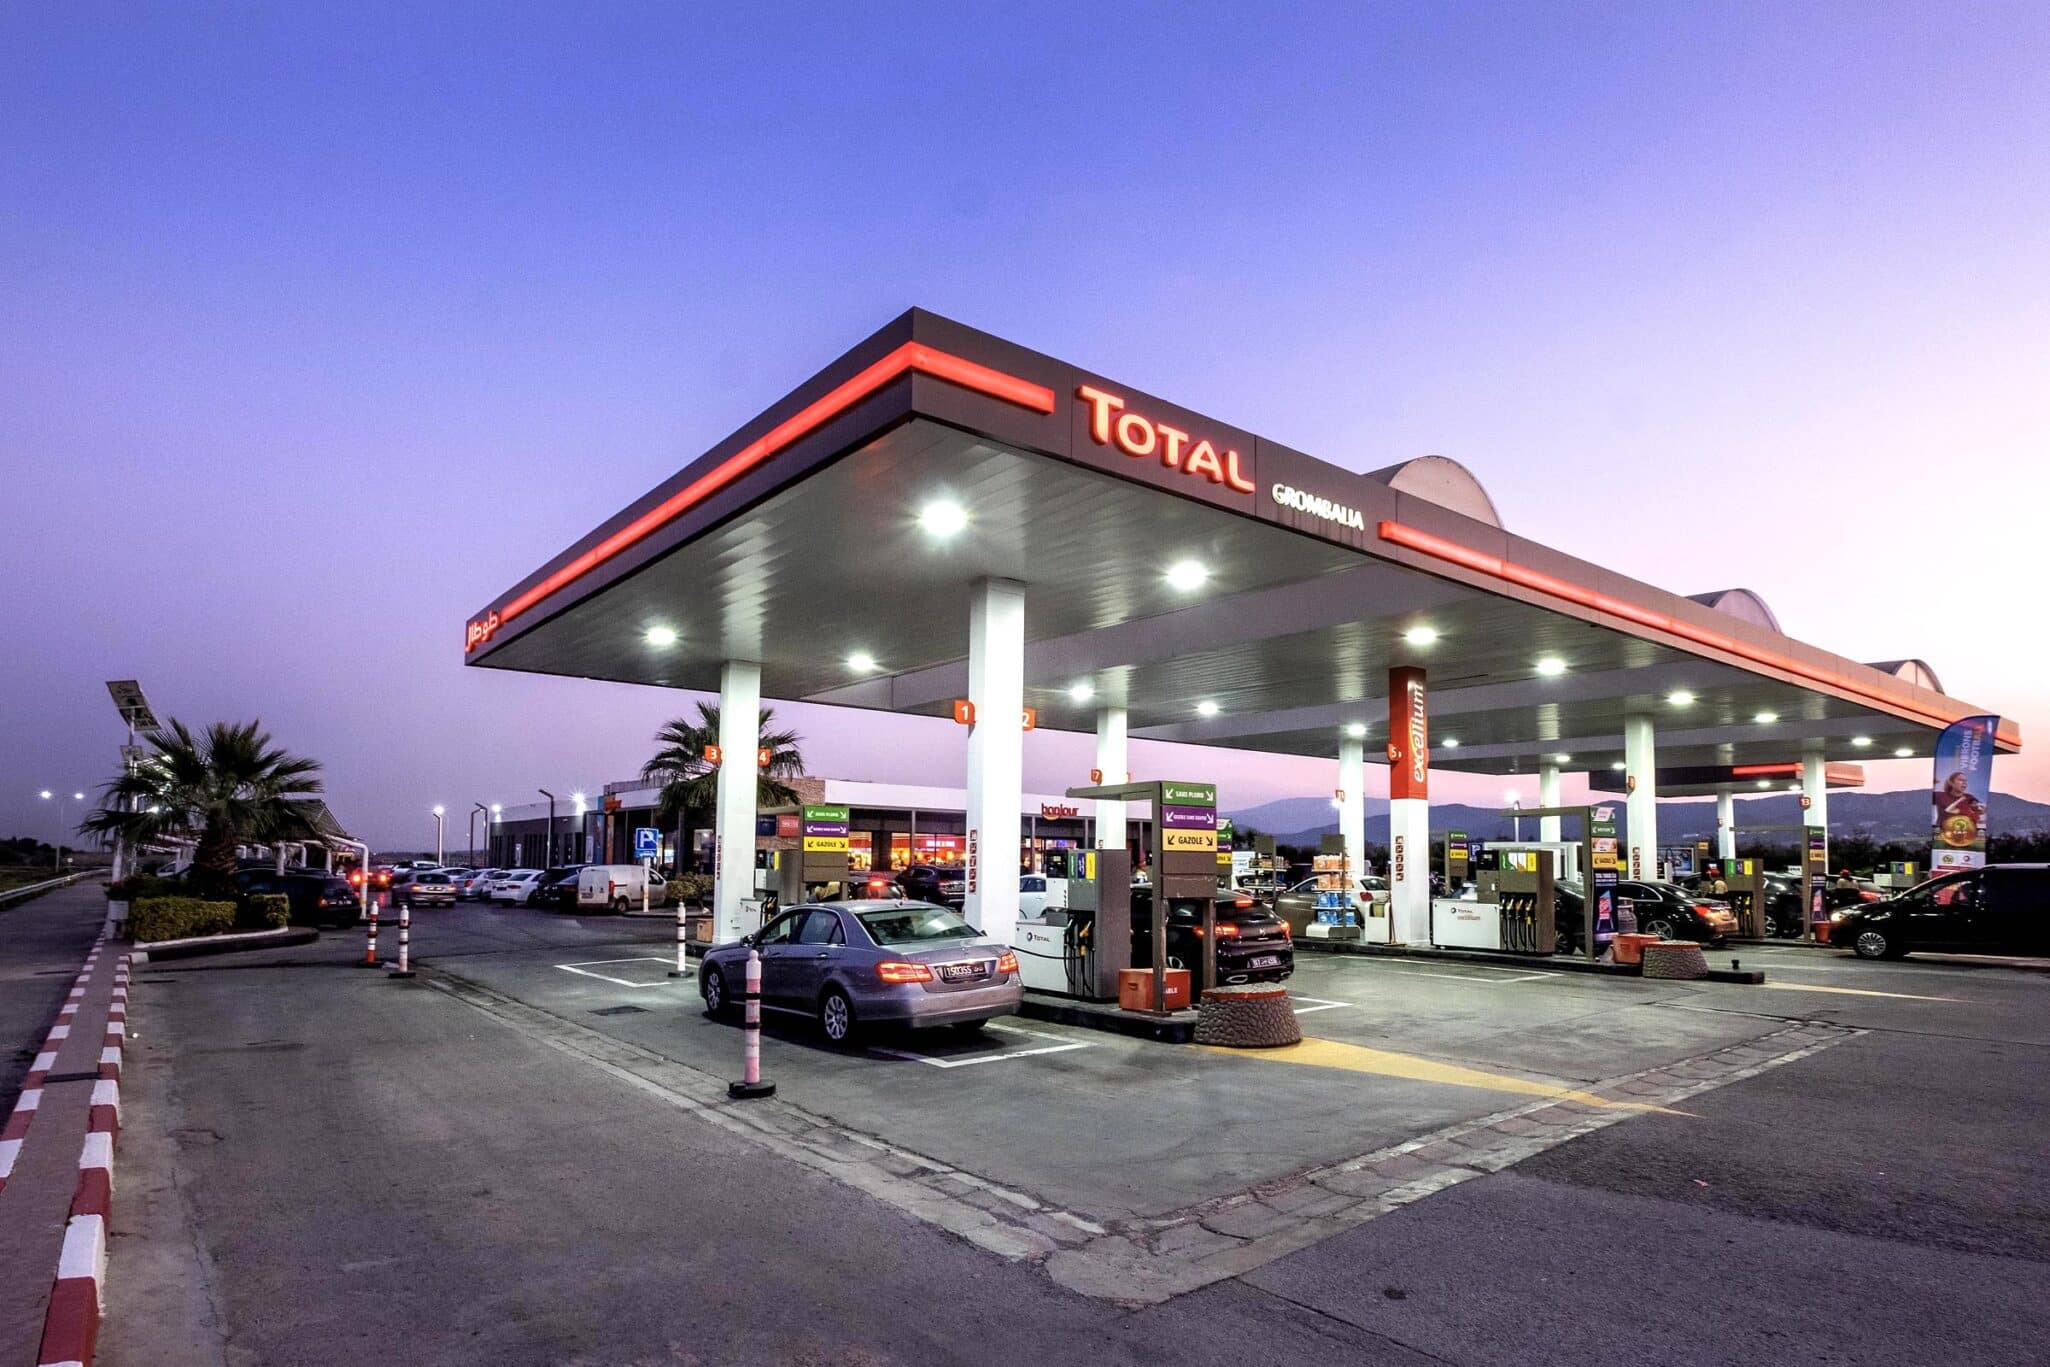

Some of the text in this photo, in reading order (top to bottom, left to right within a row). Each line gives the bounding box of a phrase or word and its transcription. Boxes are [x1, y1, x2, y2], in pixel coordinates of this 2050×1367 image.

[1077, 384, 1255, 493] TOTAL
[1271, 483, 1365, 531] GROMBALIA
[961, 705, 969, 721] 1
[1021, 711, 1030, 727] 2
[1411, 682, 1425, 783] excellium
[710, 748, 718, 760] 3
[758, 751, 767, 763] 4
[1391, 746, 1397, 758] 5
[1801, 797, 1810, 807] 13
[1041, 803, 1080, 816] bonjour
[640, 830, 655, 848] P
[1178, 836, 1203, 845] GAZOLE
